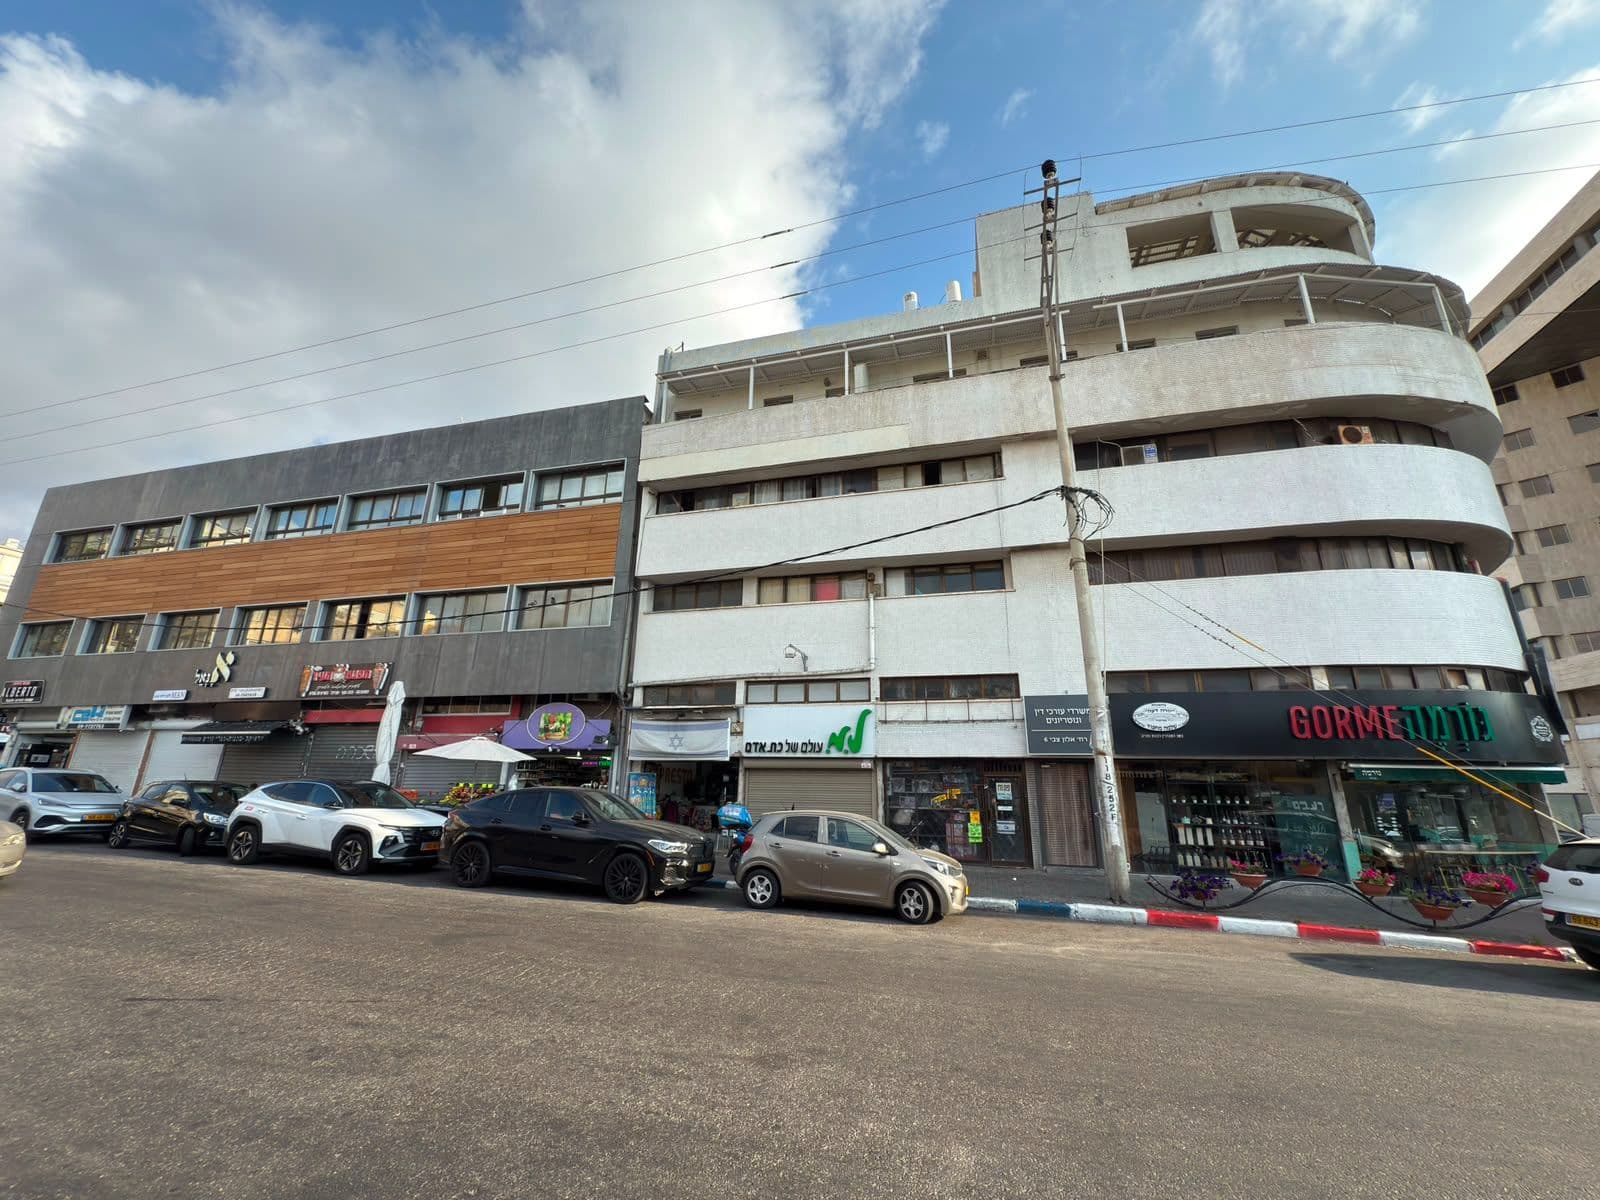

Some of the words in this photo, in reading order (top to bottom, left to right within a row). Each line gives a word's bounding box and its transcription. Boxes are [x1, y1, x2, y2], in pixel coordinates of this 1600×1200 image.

[0, 686, 38, 698] ALBERTO
[1034, 708, 1044, 717] דין
[1046, 708, 1066, 716] עורכי
[1289, 705, 1402, 740] GORME
[744, 741, 766, 753] אדם
[785, 738, 798, 753] של
[801, 738, 823, 753] עולם
